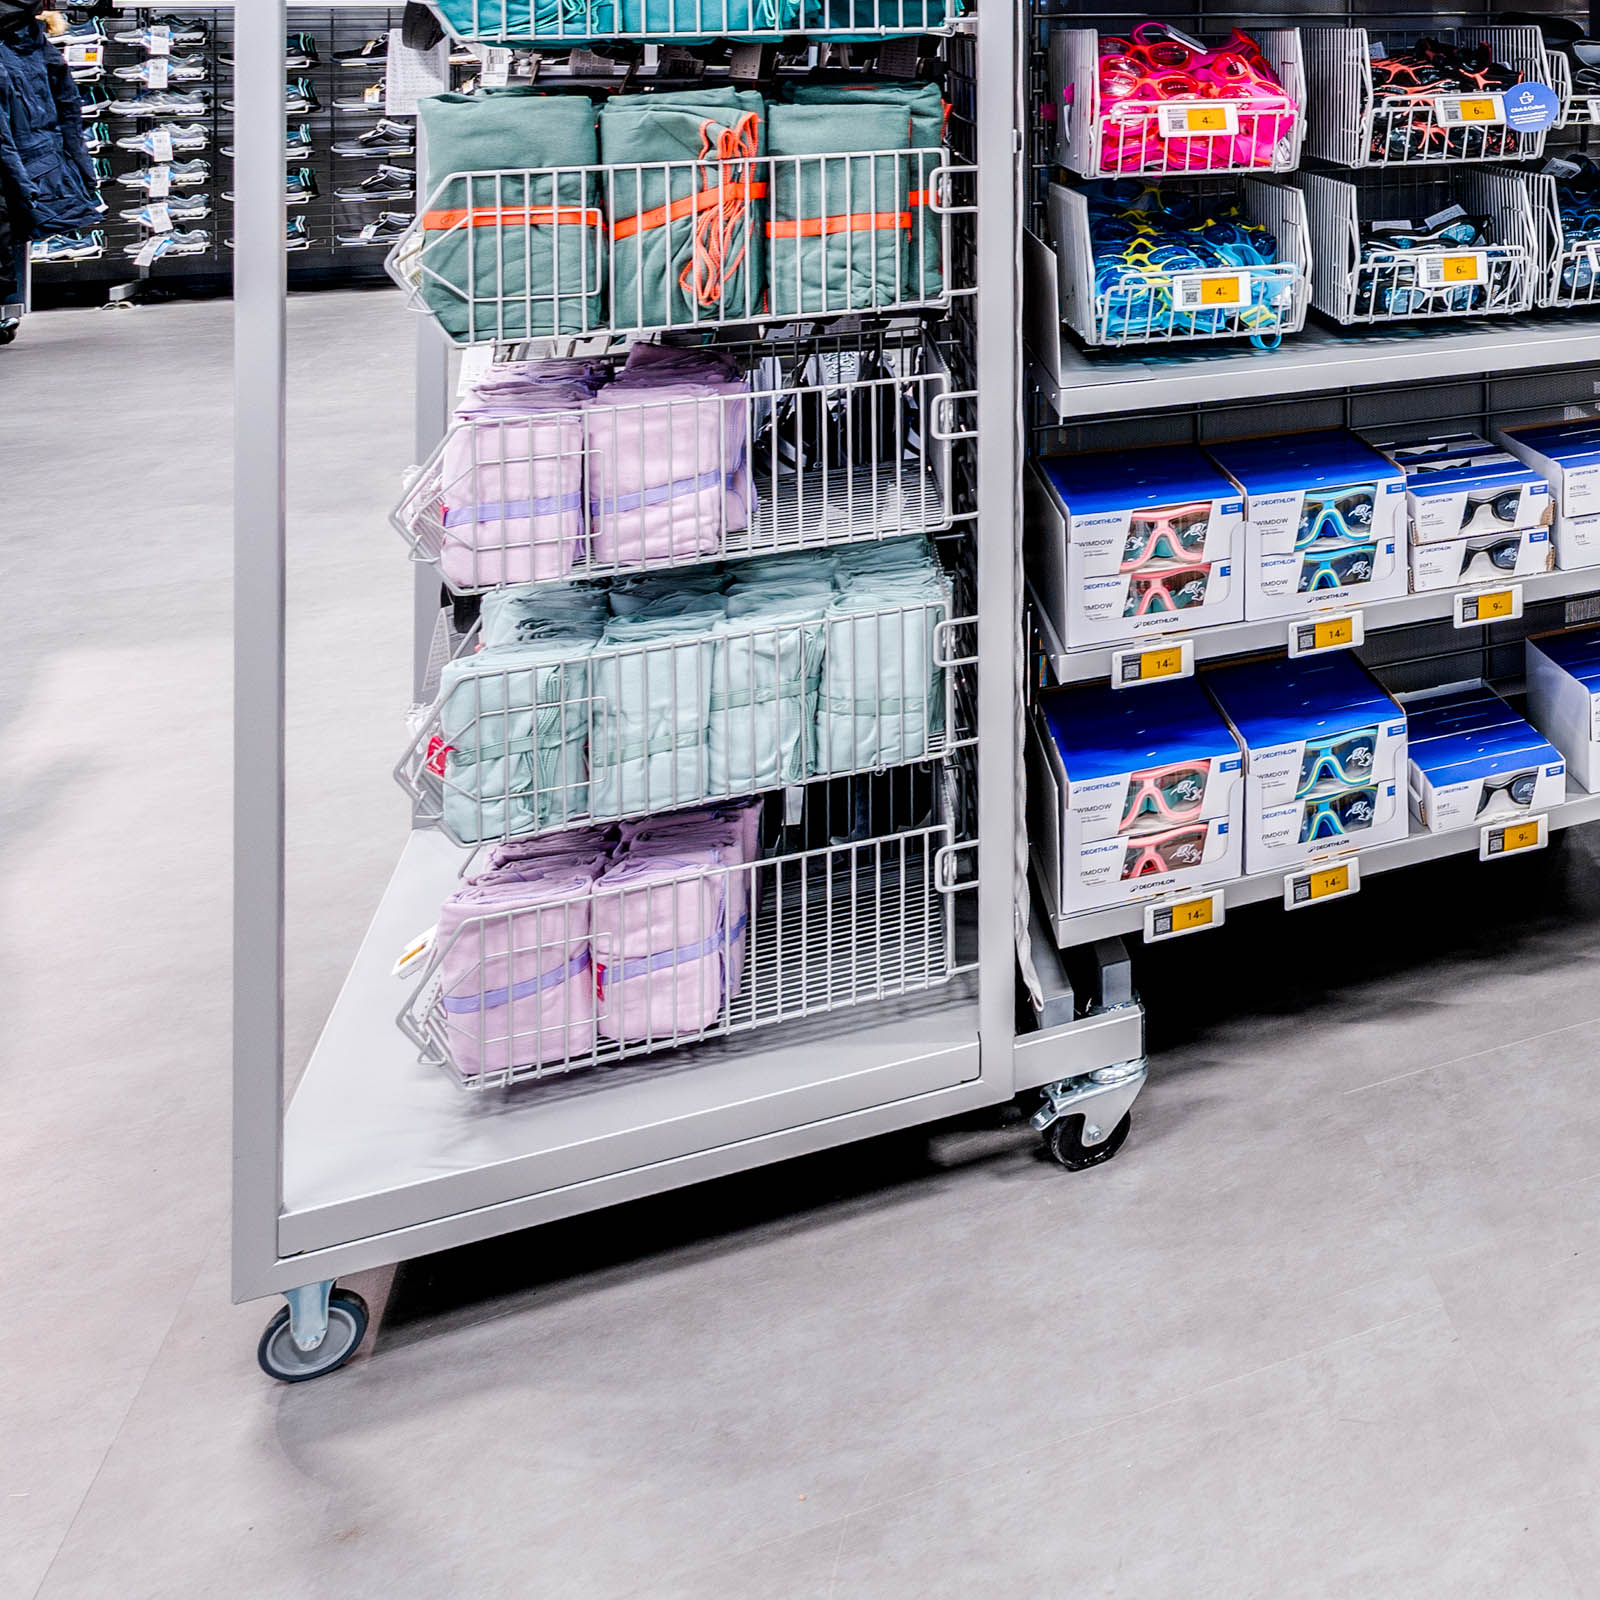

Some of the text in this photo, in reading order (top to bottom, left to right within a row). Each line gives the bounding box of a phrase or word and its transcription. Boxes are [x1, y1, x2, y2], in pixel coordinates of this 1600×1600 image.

[1315, 592, 1350, 601] DECATHLON
[1143, 617, 1179, 627] DECATHLON
[1316, 840, 1350, 851] DECATHLON
[1139, 879, 1176, 890] DECATHLON
